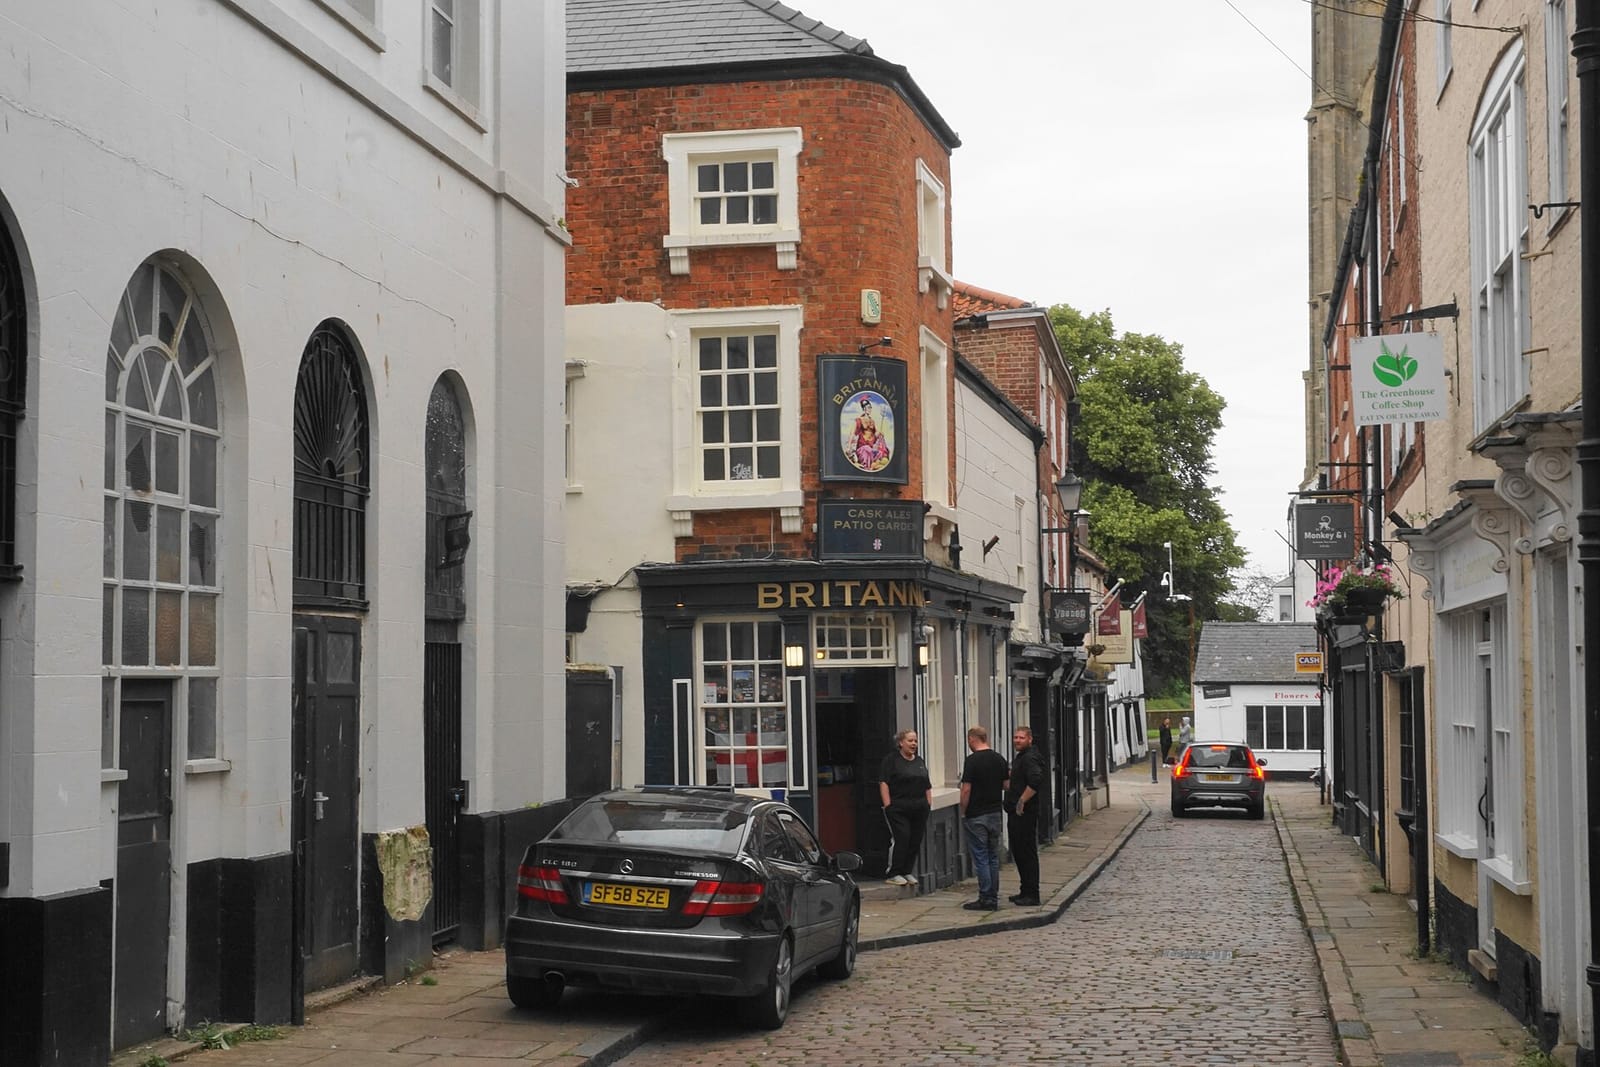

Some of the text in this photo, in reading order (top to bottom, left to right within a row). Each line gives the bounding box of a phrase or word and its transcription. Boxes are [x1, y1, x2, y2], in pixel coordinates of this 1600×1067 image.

[1361, 387, 1436, 399] The Greenhouse
[1371, 400, 1425, 410] Coffee Shop
[847, 508, 911, 520] CASK ALES
[833, 520, 874, 529] PATIO
[1304, 531, 1335, 541] Monkey
[1335, 531, 1342, 539] &
[1298, 656, 1320, 664] CASH
[593, 886, 665, 905] SF58 SZE
